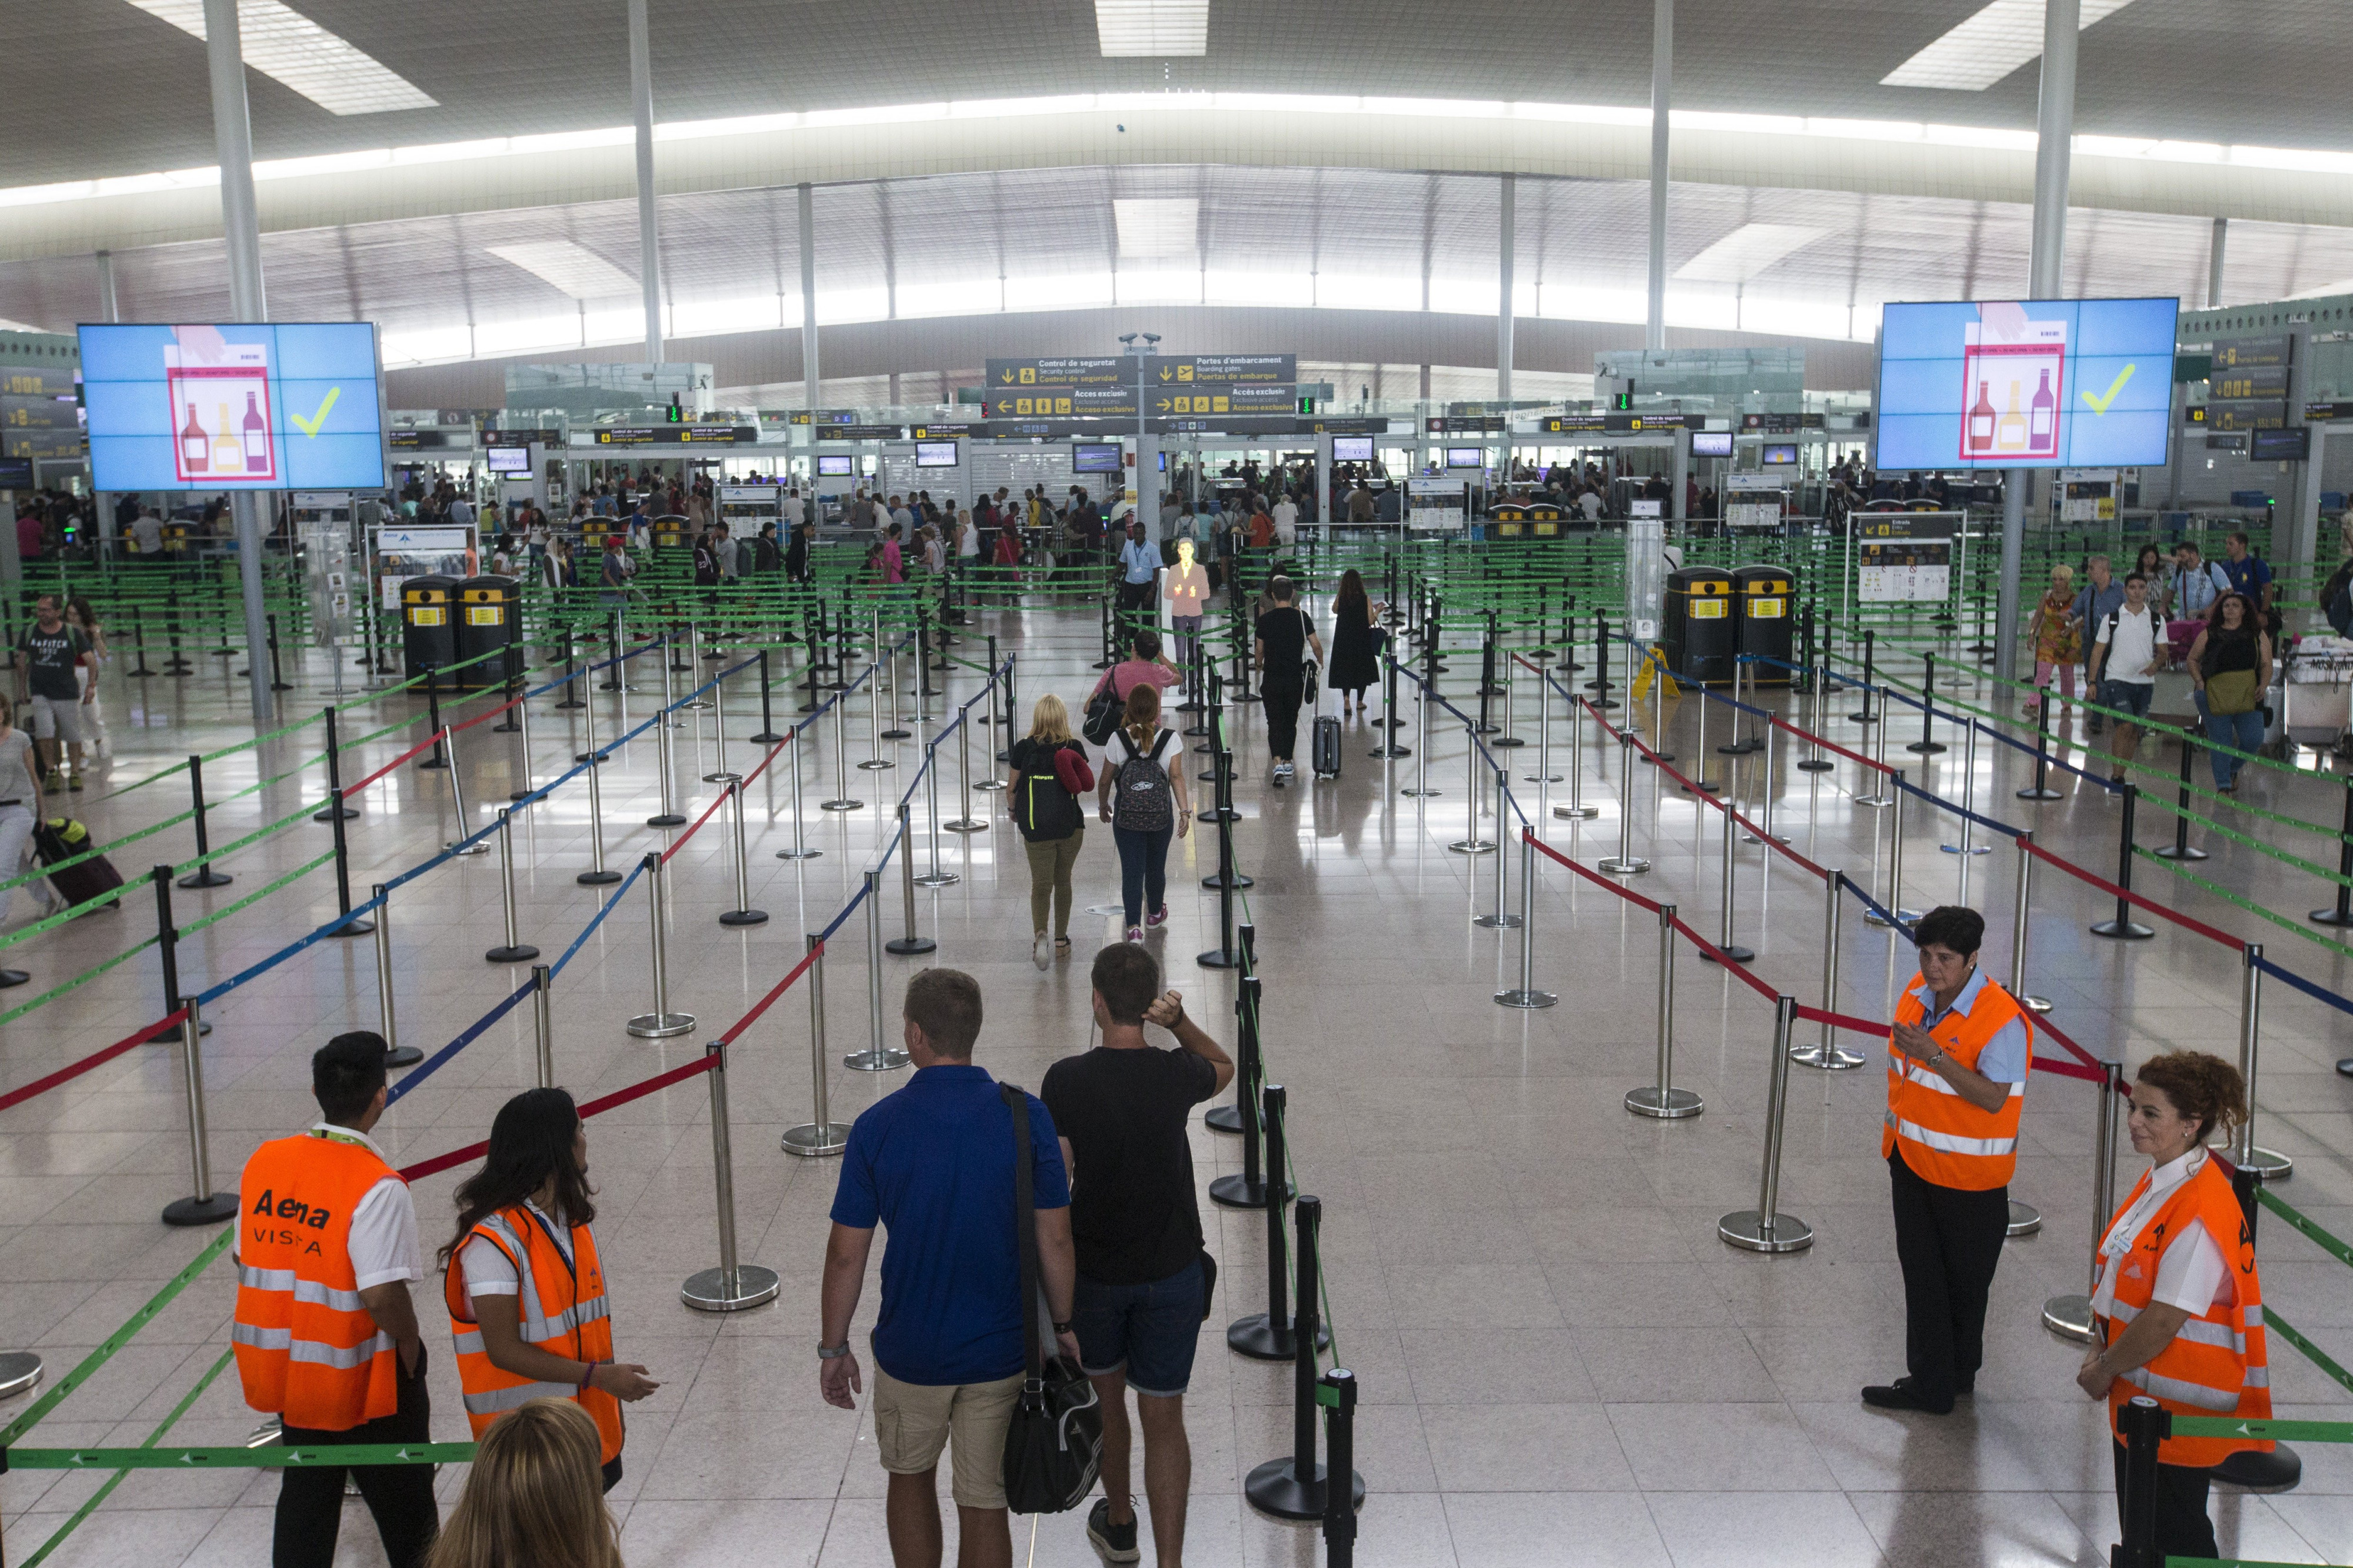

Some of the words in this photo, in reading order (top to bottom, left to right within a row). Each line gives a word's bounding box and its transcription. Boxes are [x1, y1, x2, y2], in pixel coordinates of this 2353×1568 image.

[1080, 359, 1116, 368] seguretat
[1081, 375, 1118, 383] seguridad
[698, 561, 706, 569] 23
[254, 1189, 331, 1230] Aena
